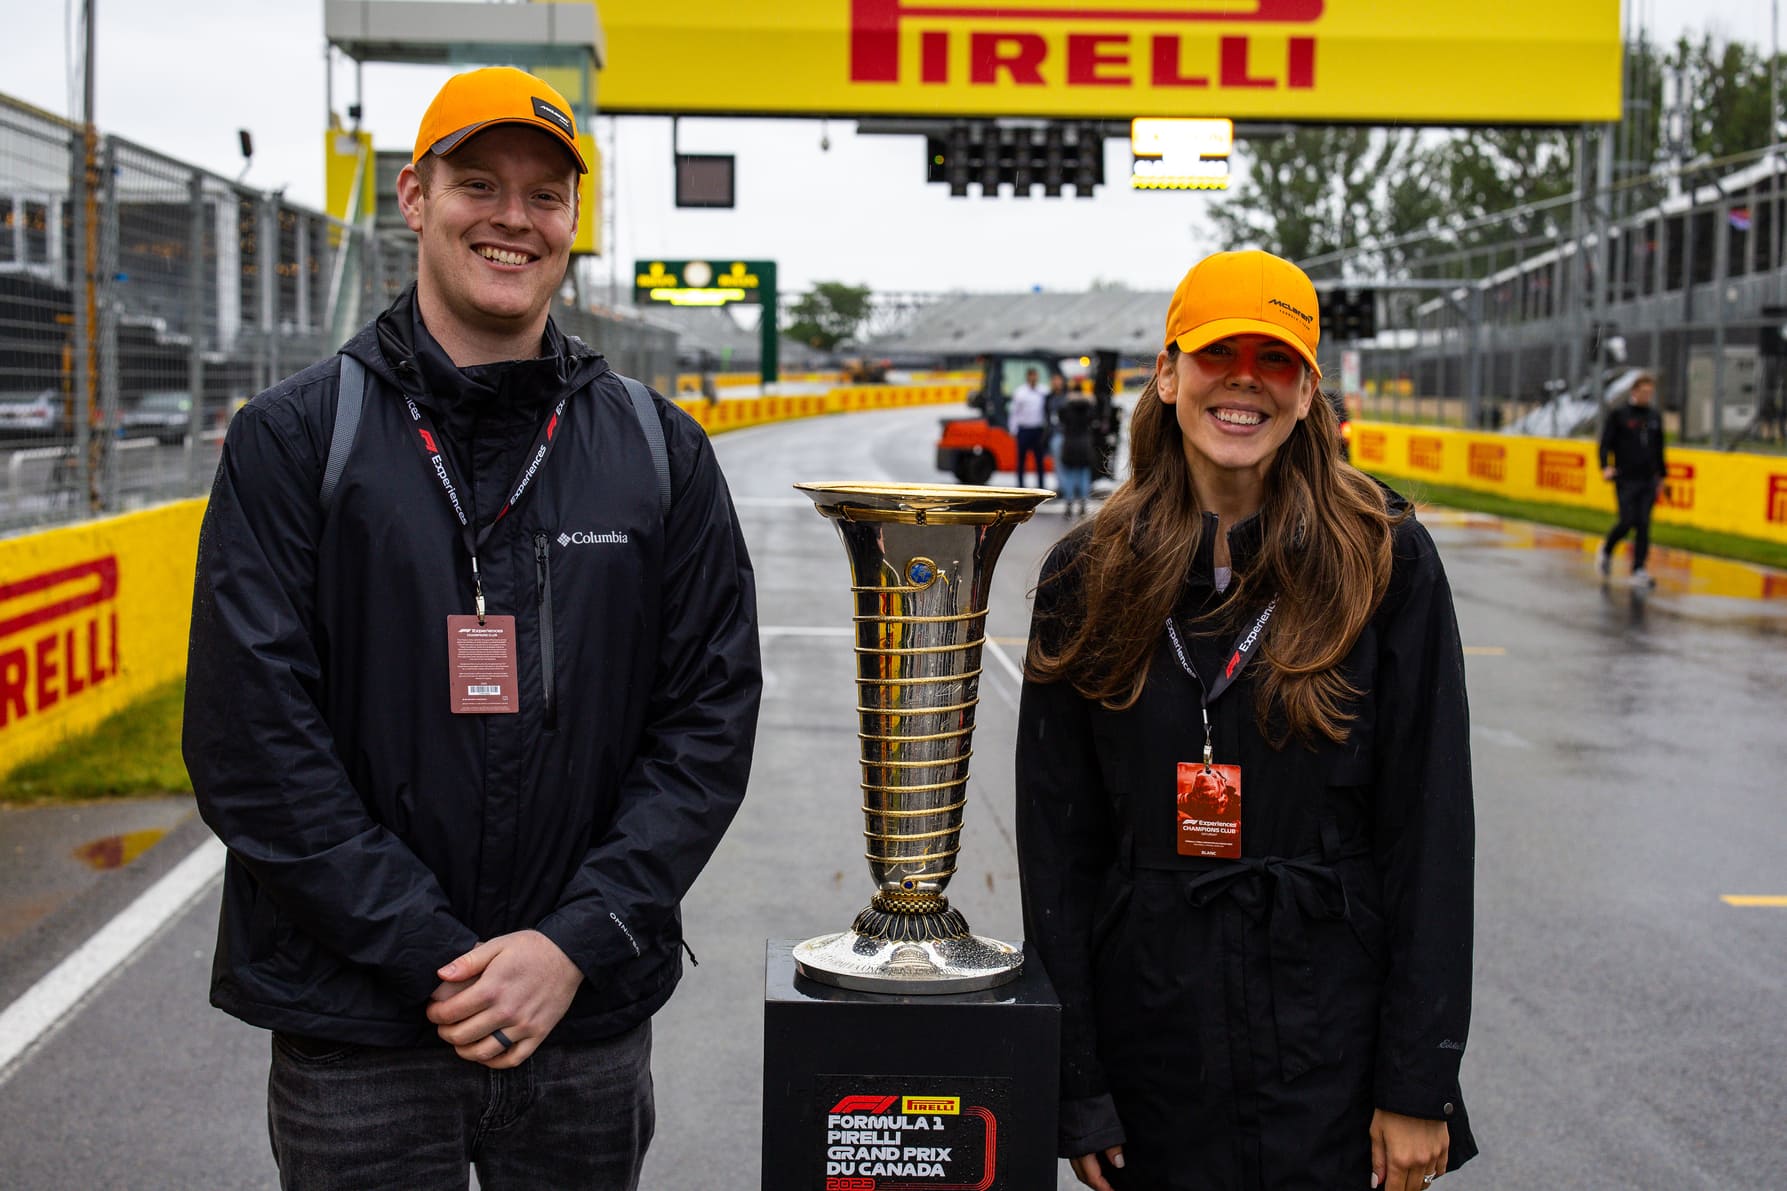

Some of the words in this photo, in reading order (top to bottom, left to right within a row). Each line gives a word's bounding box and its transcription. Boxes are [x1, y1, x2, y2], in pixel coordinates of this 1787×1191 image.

[849, 0, 1326, 90] PIRELLI
[510, 443, 547, 506] Experiences
[431, 454, 468, 526] Experiences
[571, 531, 628, 544] Columbia
[1238, 592, 1281, 652] Experienc
[1183, 825, 1220, 833] CHAMPIONS
[1199, 820, 1237, 828] Experiences
[906, 1099, 956, 1112] PIRELLI
[827, 1114, 930, 1131] FORMULA
[933, 1116, 945, 1131] 1
[827, 1130, 901, 1146] PIRELLI
[827, 1146, 901, 1162] GRAND
[903, 1148, 953, 1162] PRIX
[826, 1161, 856, 1176] DU
[858, 1162, 946, 1178] CANADA
[825, 1177, 876, 1191] 2023
